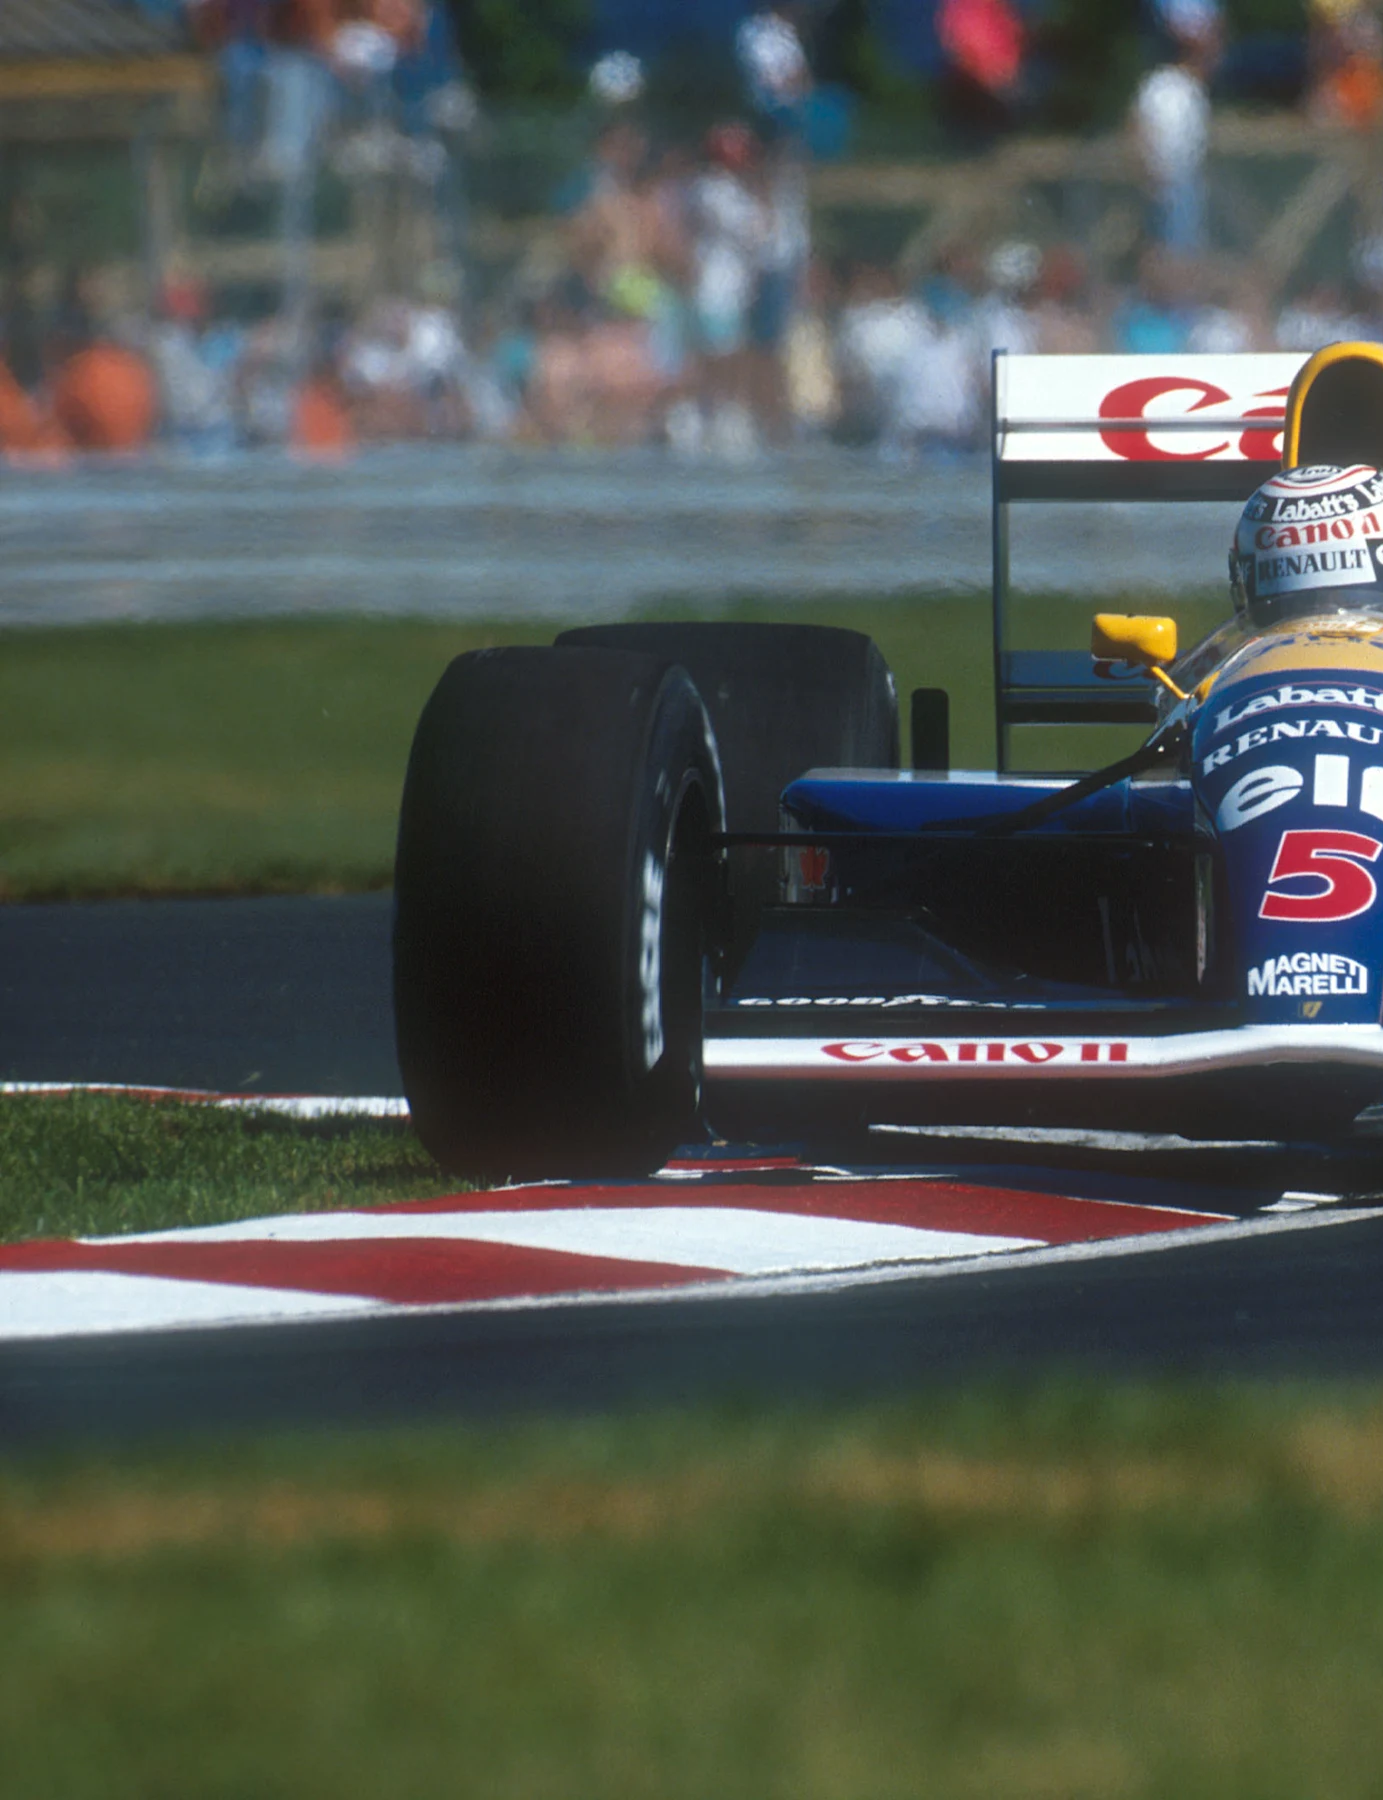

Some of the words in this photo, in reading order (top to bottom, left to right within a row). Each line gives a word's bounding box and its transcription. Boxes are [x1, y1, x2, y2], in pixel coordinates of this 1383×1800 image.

[1271, 493, 1360, 523] Labatt's
[1255, 511, 1381, 551] Canon
[1258, 548, 1367, 582] RENAULT
[1258, 829, 1383, 922] 5
[820, 1041, 1128, 1064] Canon
